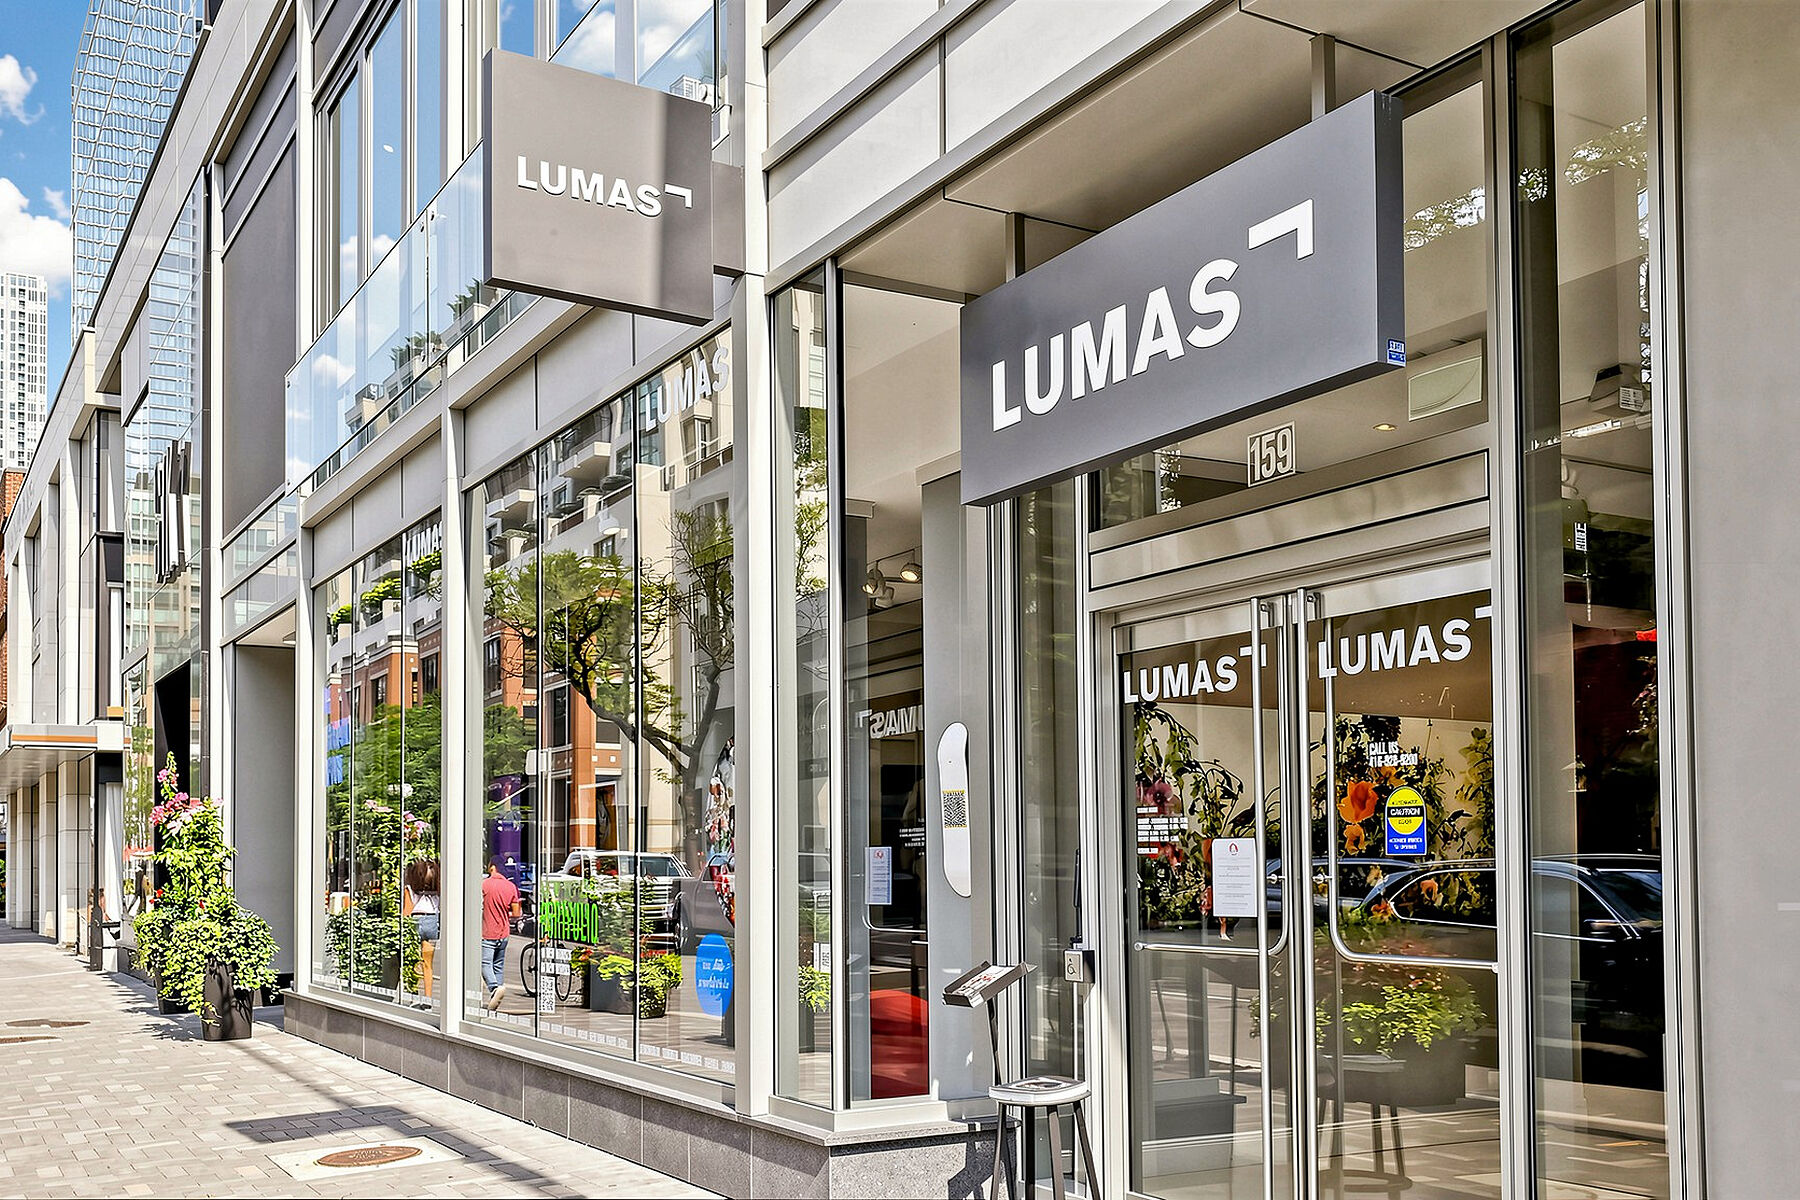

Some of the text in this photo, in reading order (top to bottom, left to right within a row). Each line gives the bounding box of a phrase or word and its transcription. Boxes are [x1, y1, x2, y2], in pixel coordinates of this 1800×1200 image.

[517, 155, 663, 218] LUMAS
[992, 258, 1241, 432] LUMAS
[645, 346, 730, 432] LUMAS
[1250, 427, 1293, 482] 159
[1123, 655, 1239, 703] LUMAS
[1318, 618, 1472, 679] LUMAS
